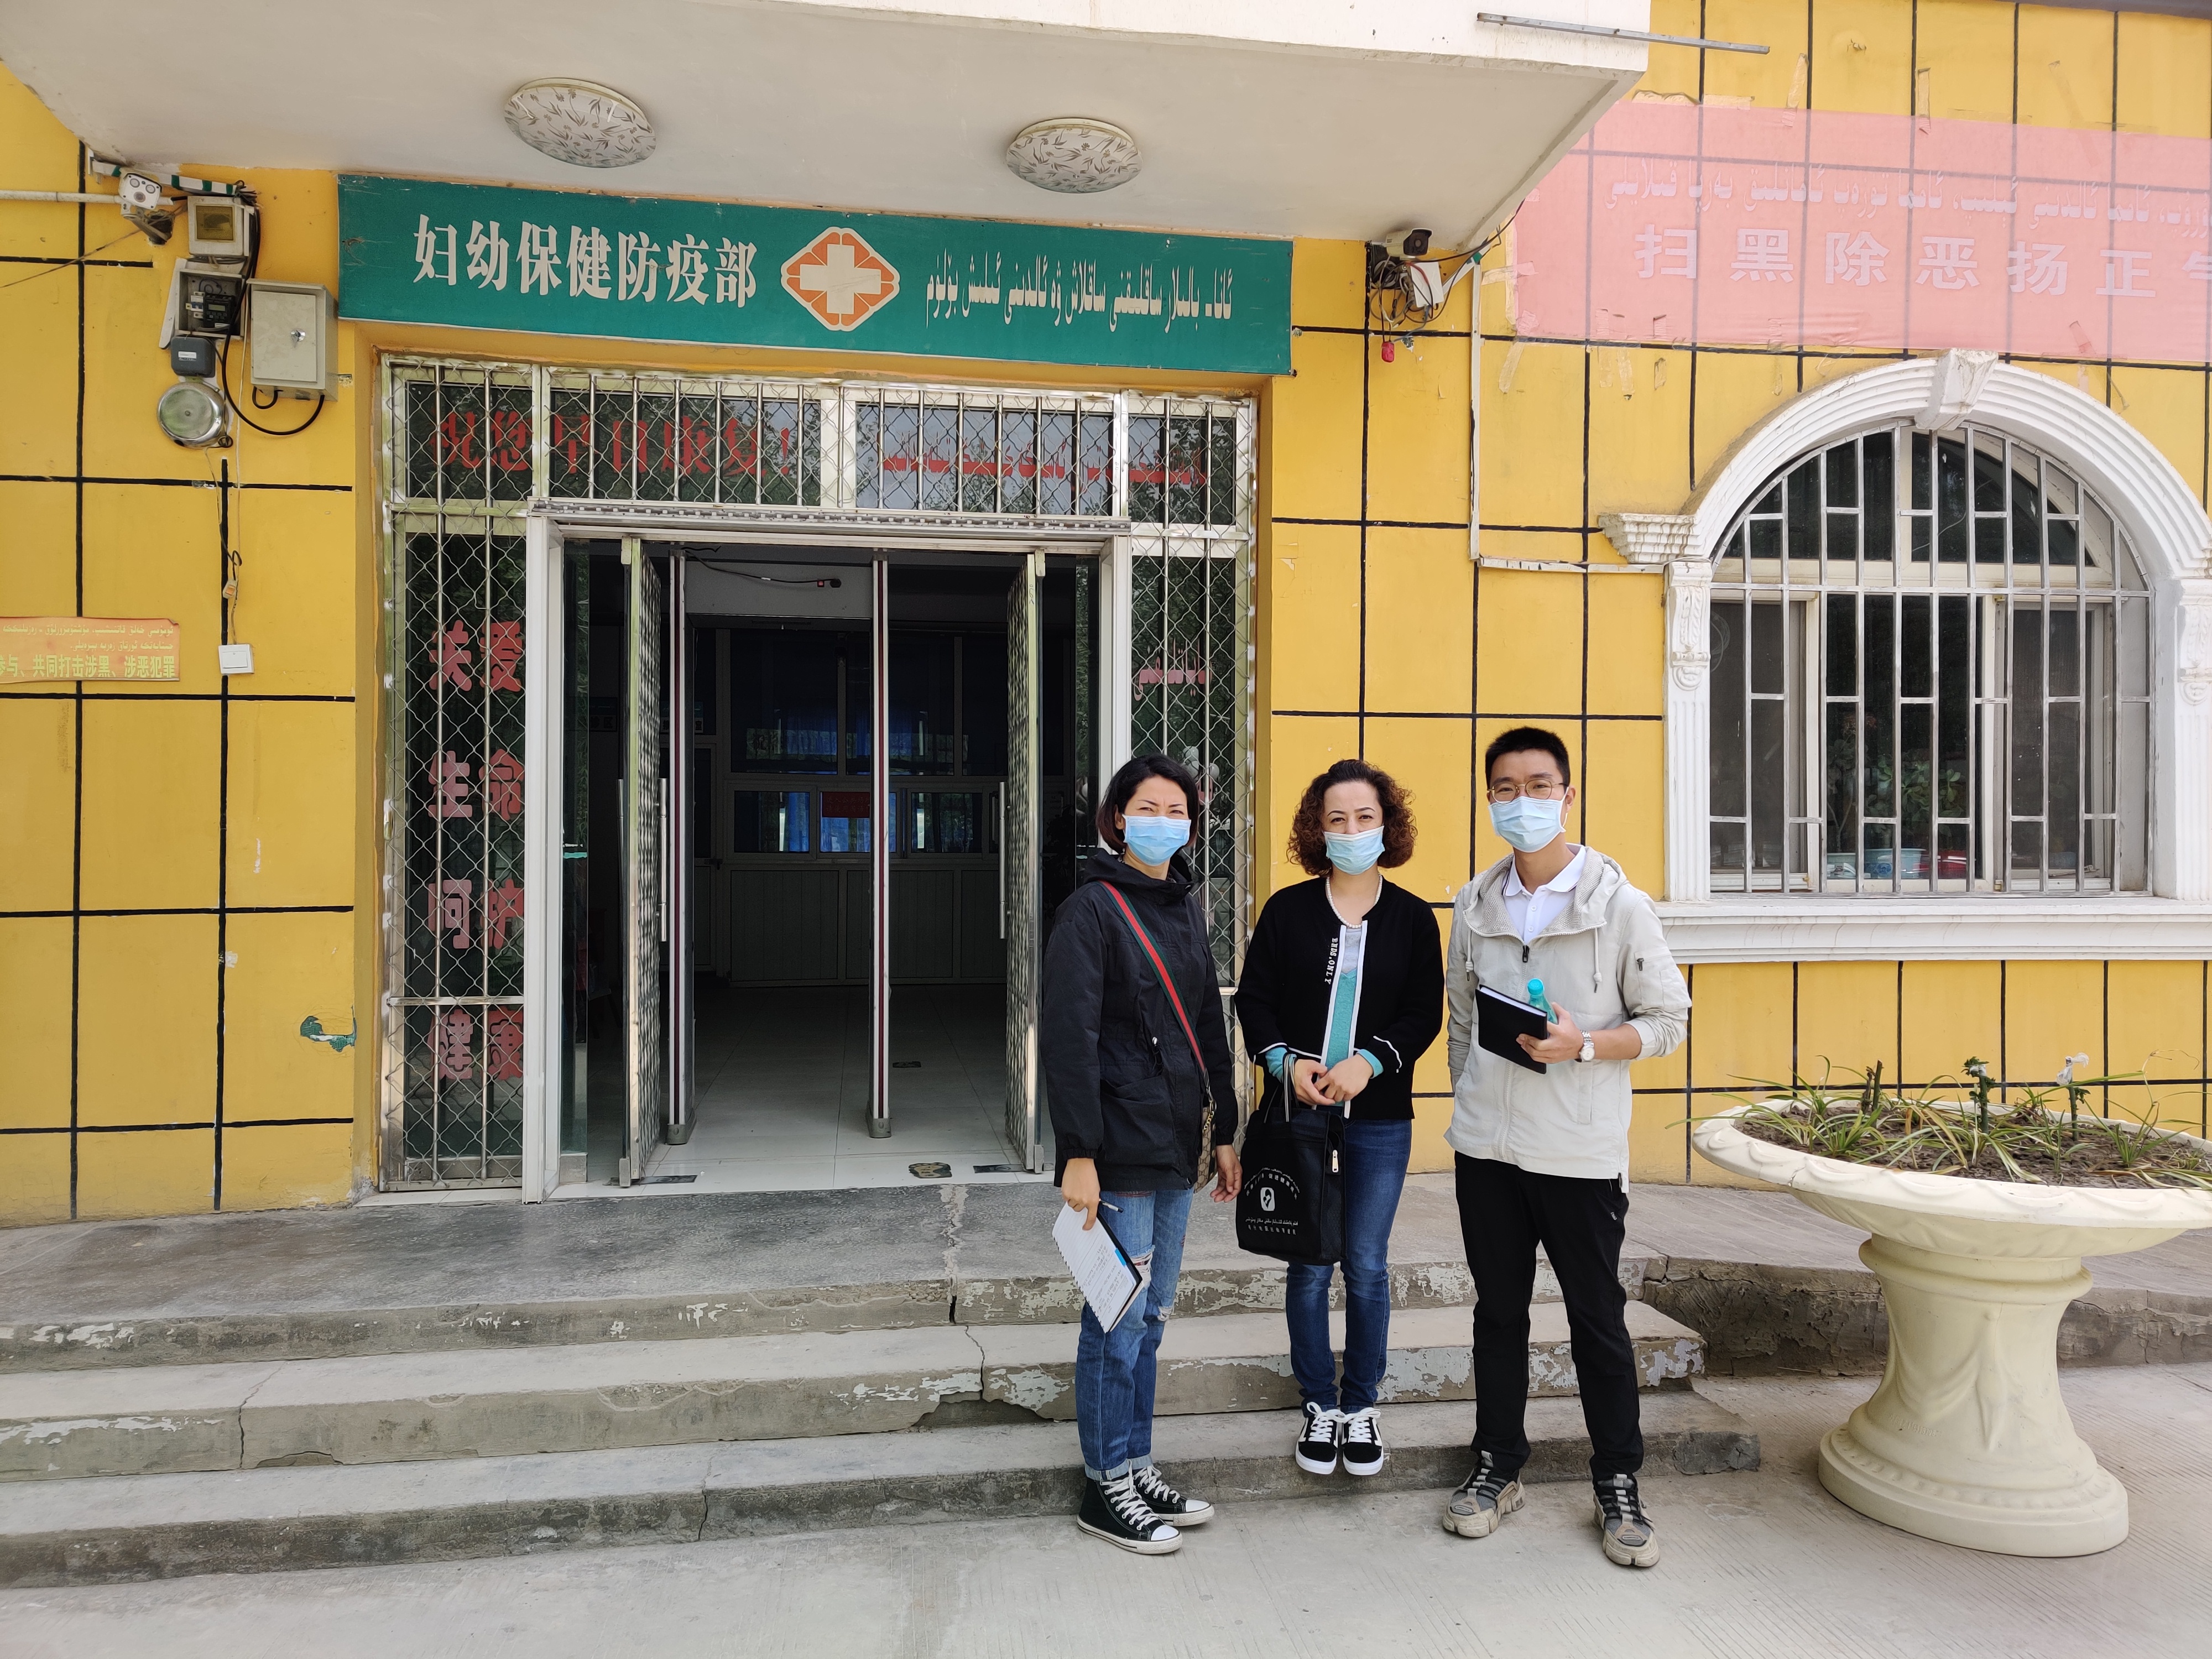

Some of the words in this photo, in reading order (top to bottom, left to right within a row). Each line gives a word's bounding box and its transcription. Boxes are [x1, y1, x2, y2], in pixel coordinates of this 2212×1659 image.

[413, 213, 758, 308] 妇幼保健防疫部
